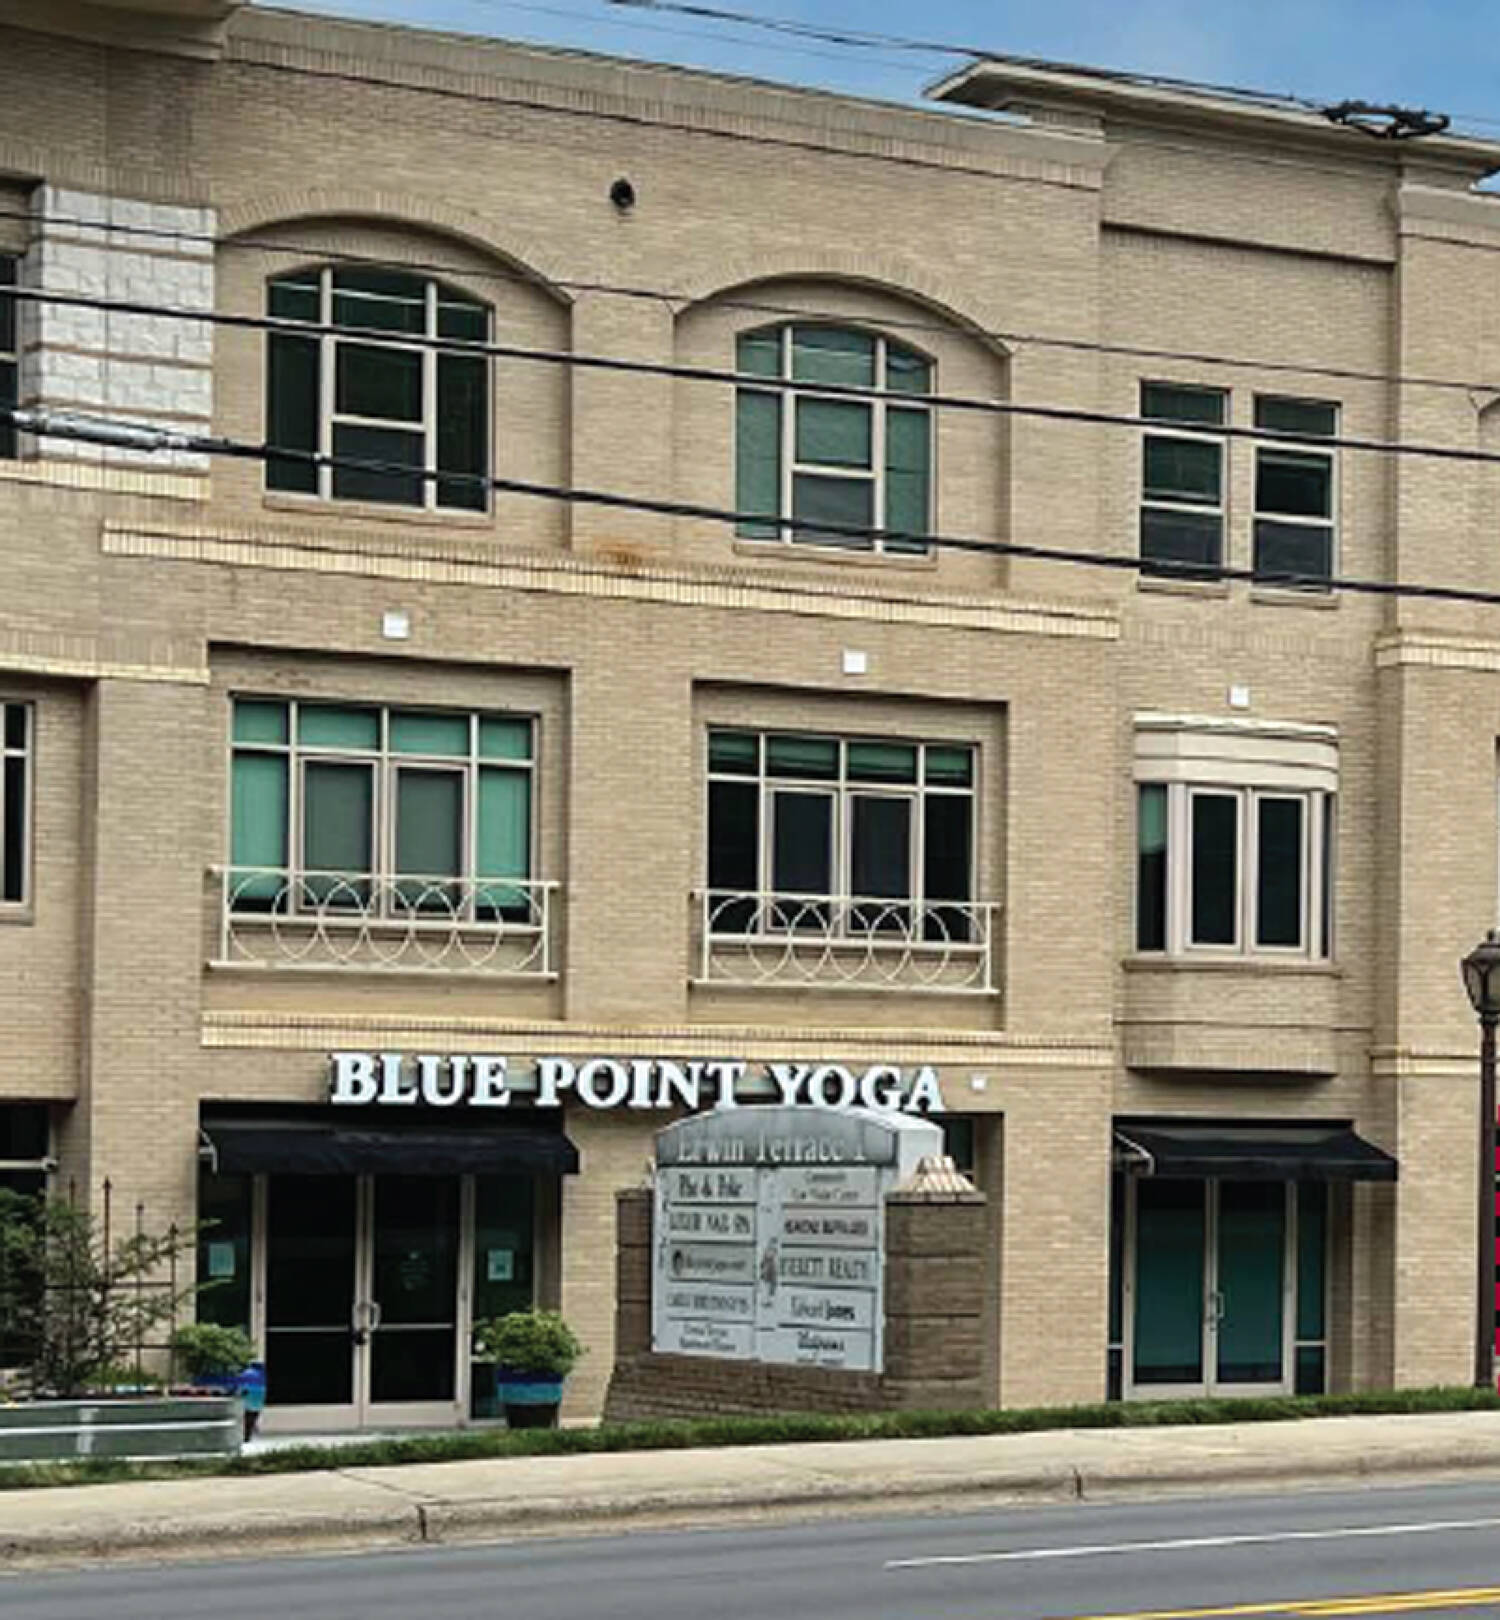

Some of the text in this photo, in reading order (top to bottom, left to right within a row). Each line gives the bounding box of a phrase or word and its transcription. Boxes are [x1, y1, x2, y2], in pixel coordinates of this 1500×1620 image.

[331, 1053, 946, 1112] BLUE POINT YOGA
[677, 1131, 745, 1162] Erwin
[756, 1129, 845, 1162] Terrace
